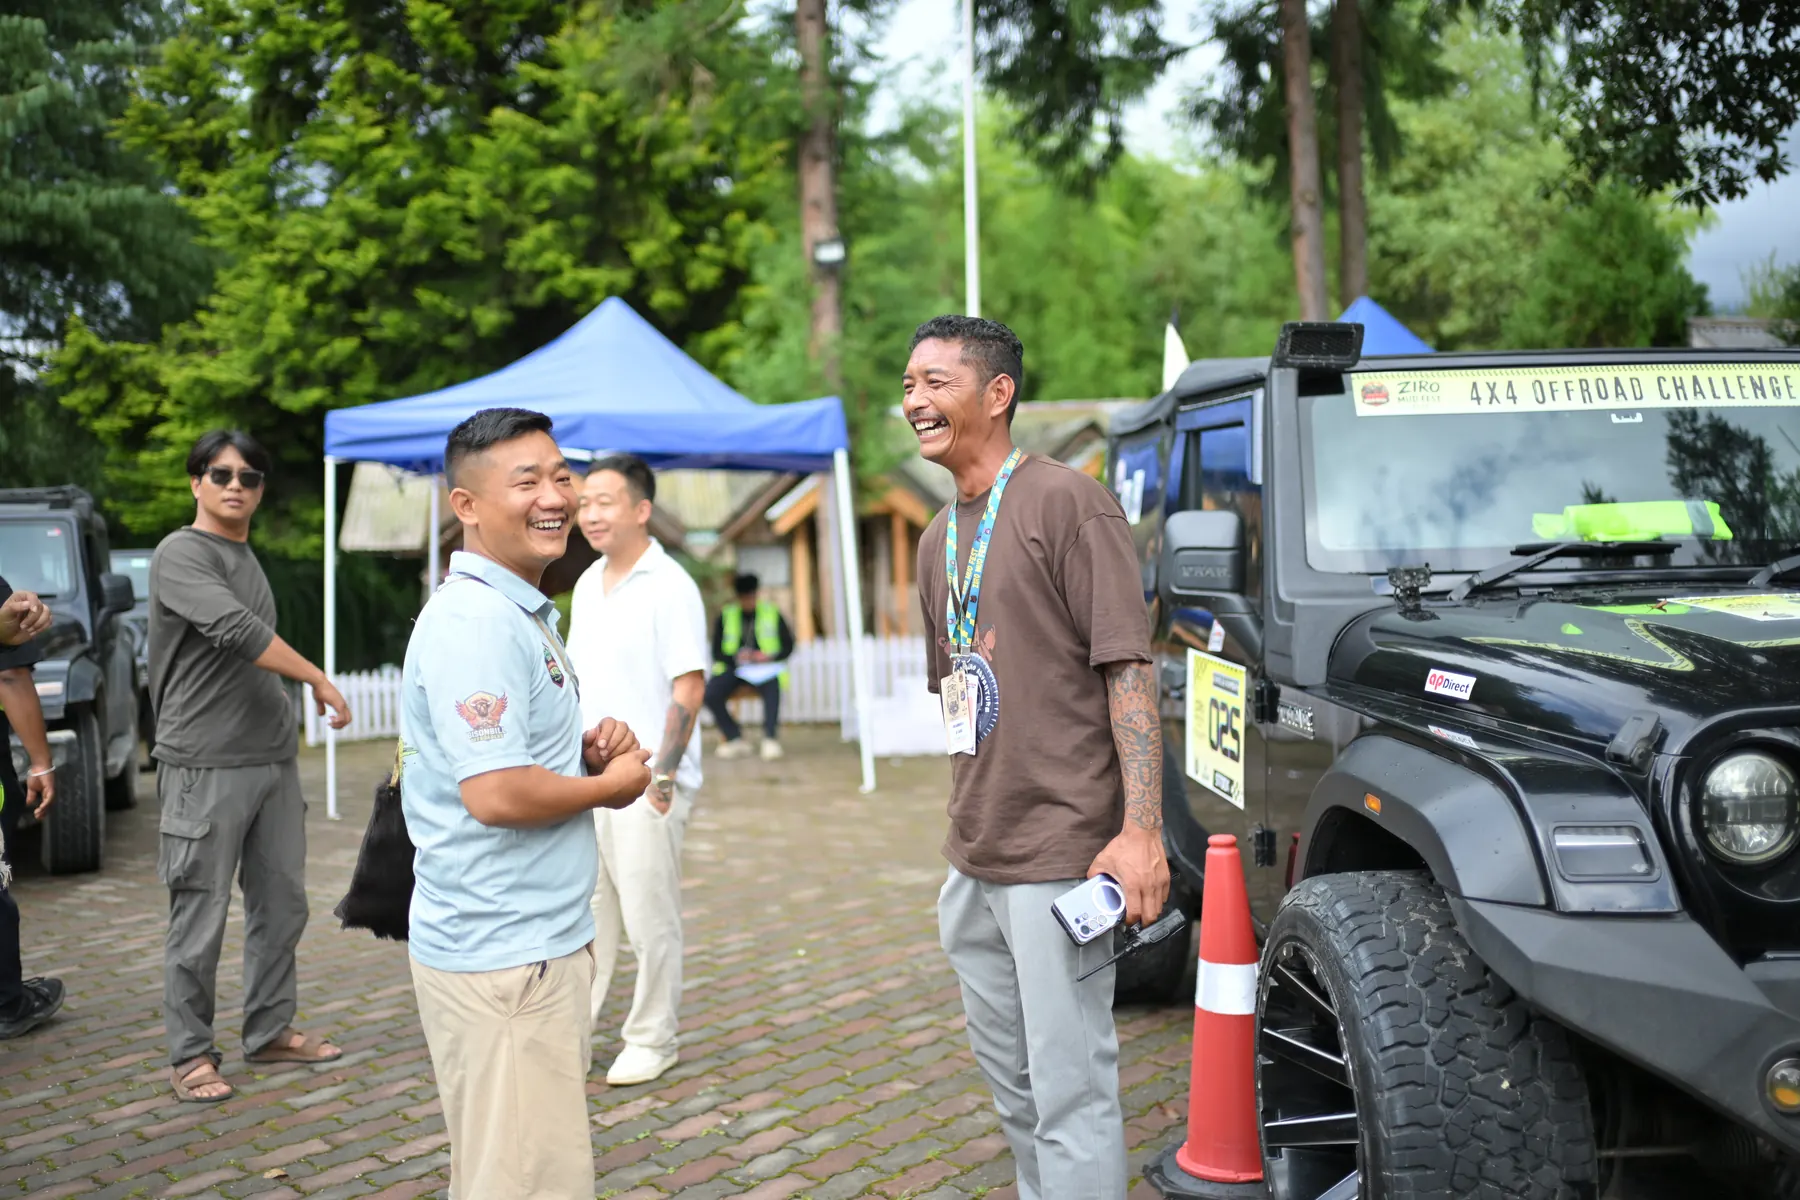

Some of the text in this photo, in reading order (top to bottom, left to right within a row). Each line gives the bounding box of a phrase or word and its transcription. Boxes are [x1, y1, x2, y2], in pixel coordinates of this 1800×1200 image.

[1397, 380, 1440, 394] ZIRO
[1470, 375, 1797, 405] 4X4 OFFROAD CHALLENGE
[976, 668, 991, 713] ADVENTURE
[1209, 697, 1241, 763] 025
